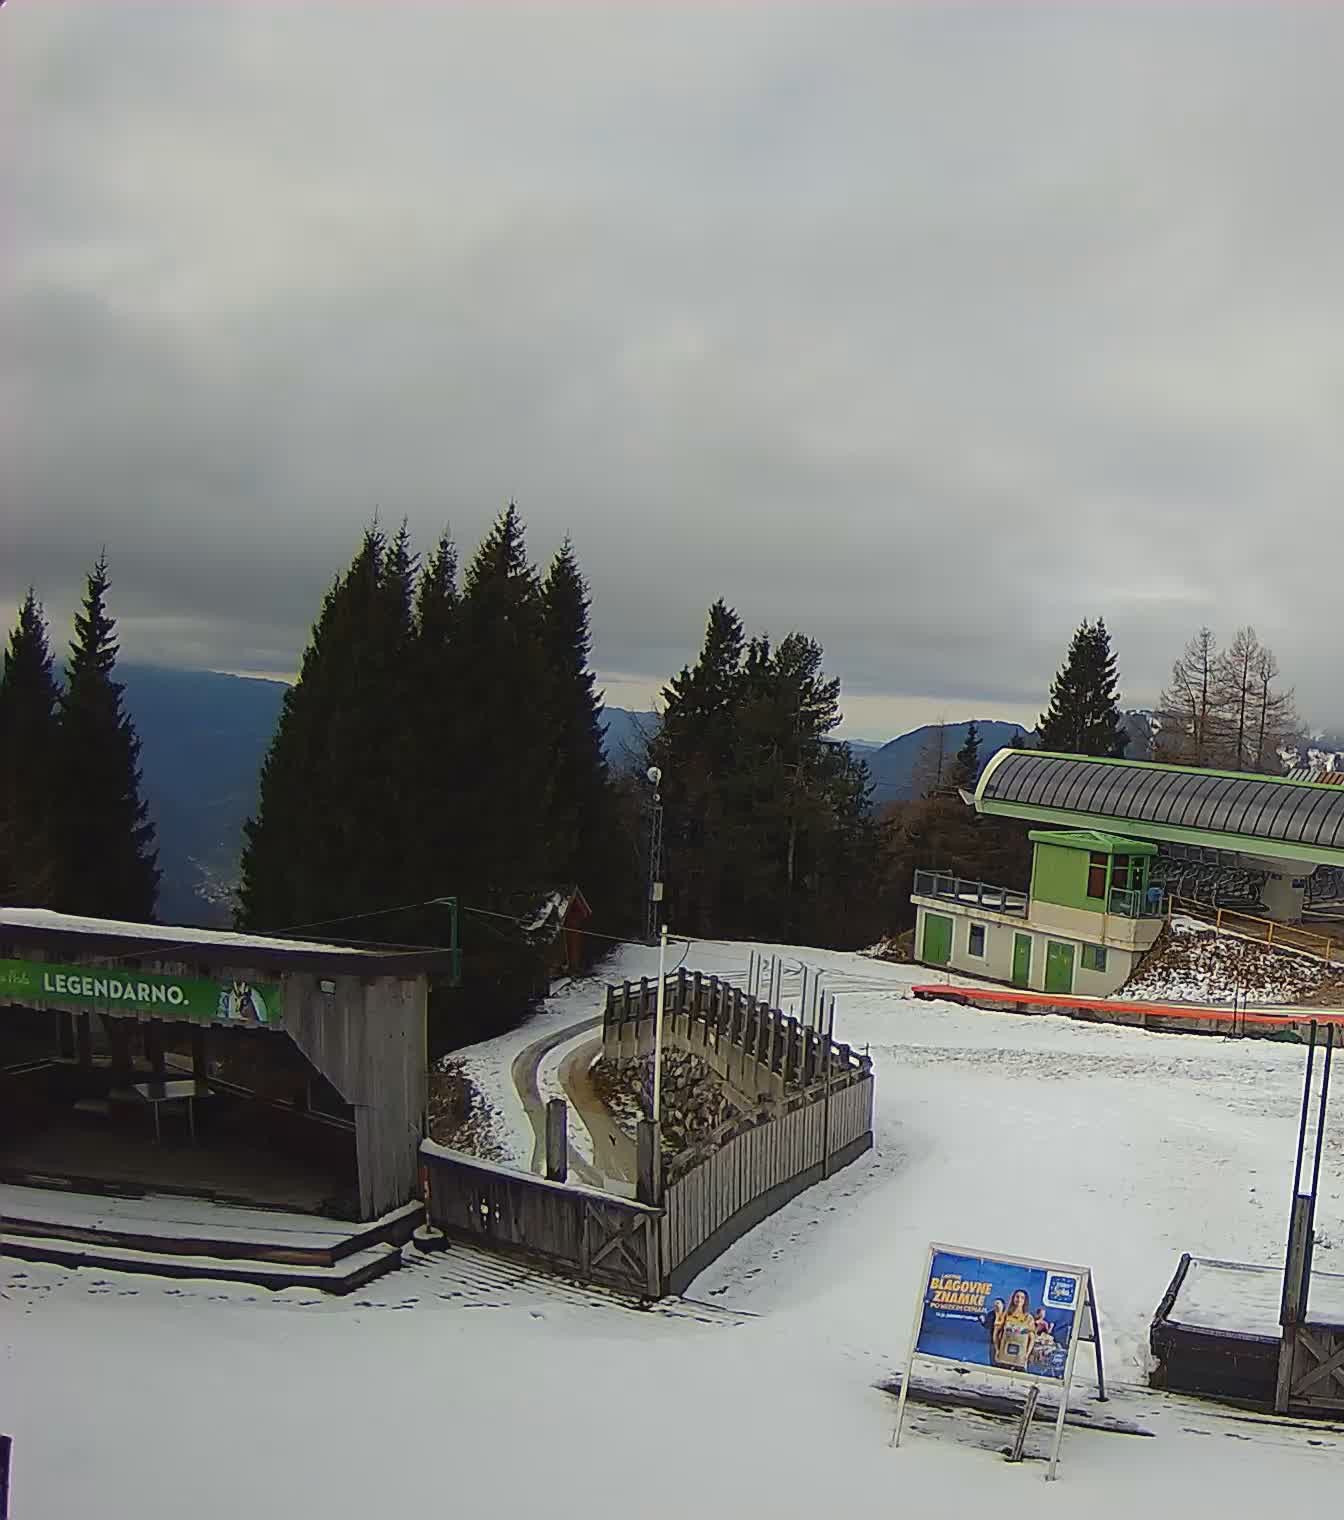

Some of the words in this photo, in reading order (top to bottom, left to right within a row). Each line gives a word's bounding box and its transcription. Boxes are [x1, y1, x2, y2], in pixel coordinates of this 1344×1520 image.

[44, 972, 190, 1006] LEGENDARNO.
[930, 1277, 993, 1296] BLAGOVNE
[932, 1290, 986, 1306] ZNAMKE
